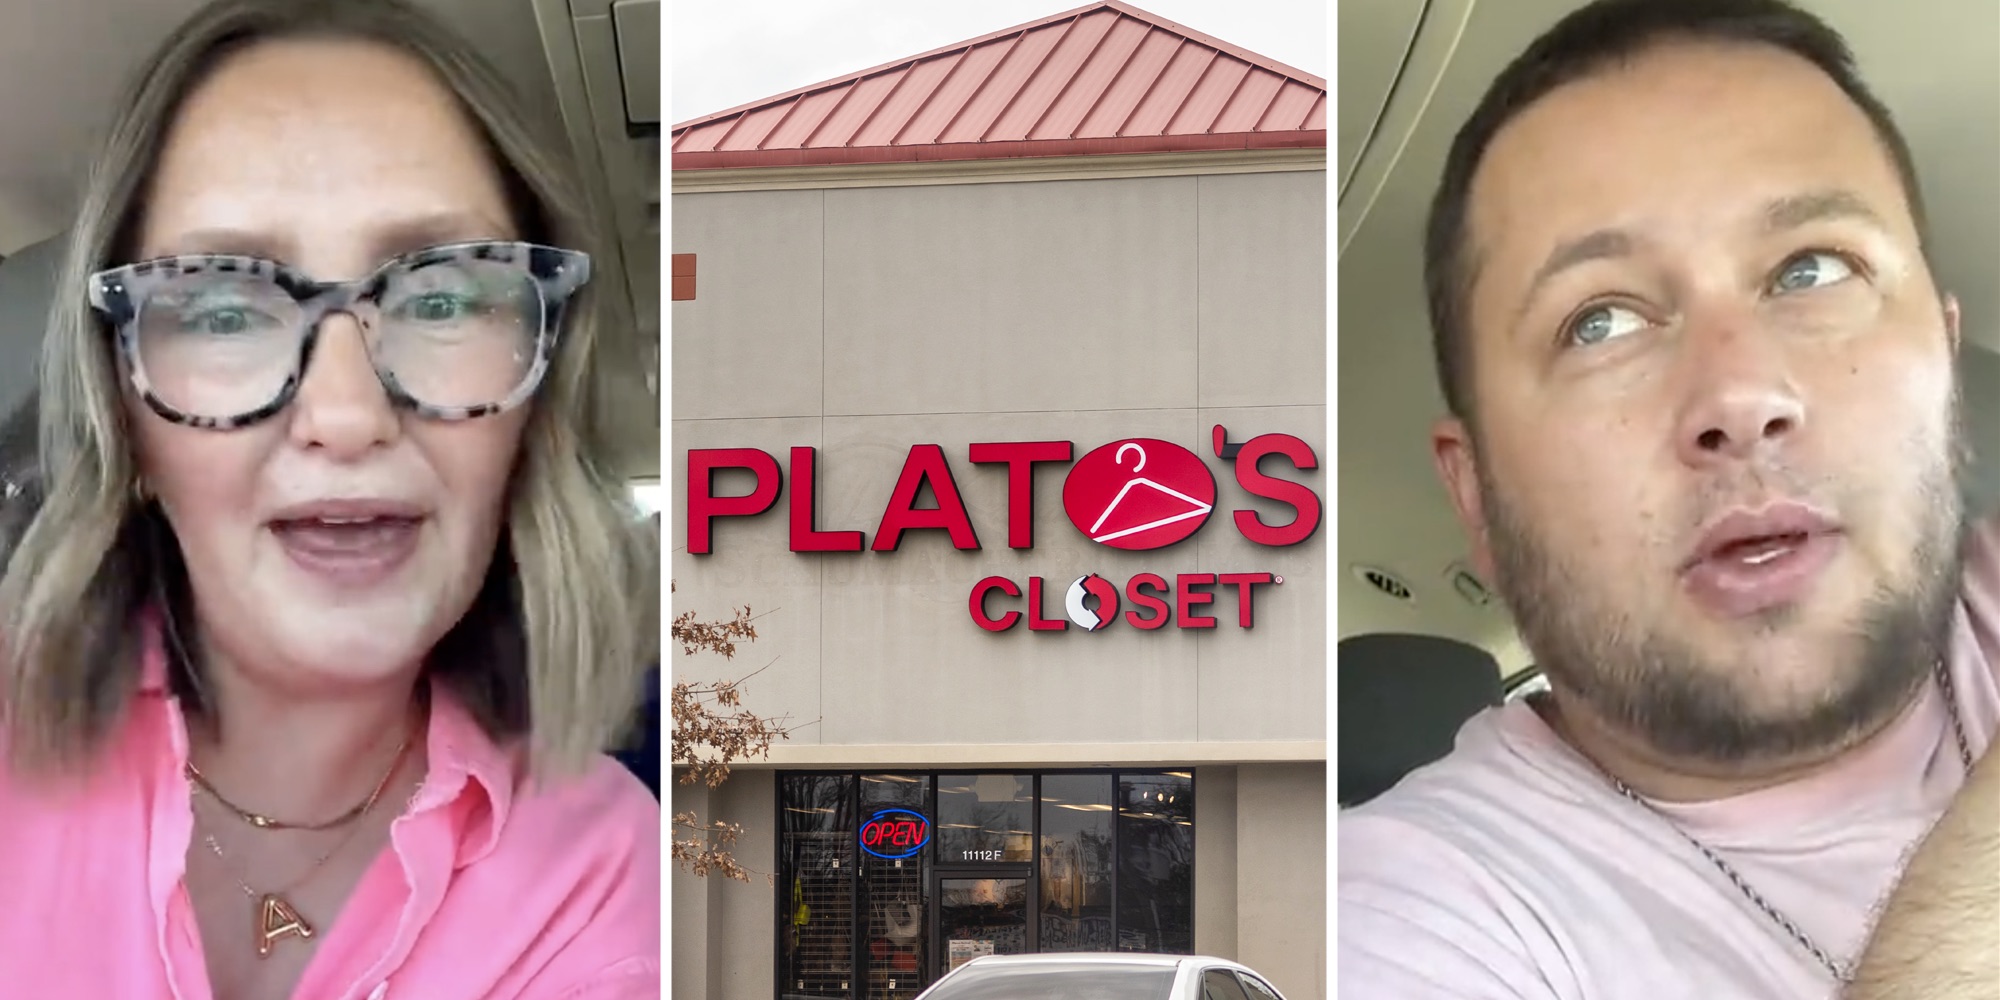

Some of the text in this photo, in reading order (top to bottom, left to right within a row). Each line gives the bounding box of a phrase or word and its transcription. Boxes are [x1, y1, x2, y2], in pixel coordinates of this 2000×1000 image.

[687, 424, 1322, 555] PLATO'S
[969, 572, 1274, 632] CLOSET
[862, 821, 926, 846] OPEN
[962, 850, 993, 861] 11112
[259, 894, 314, 958] A
